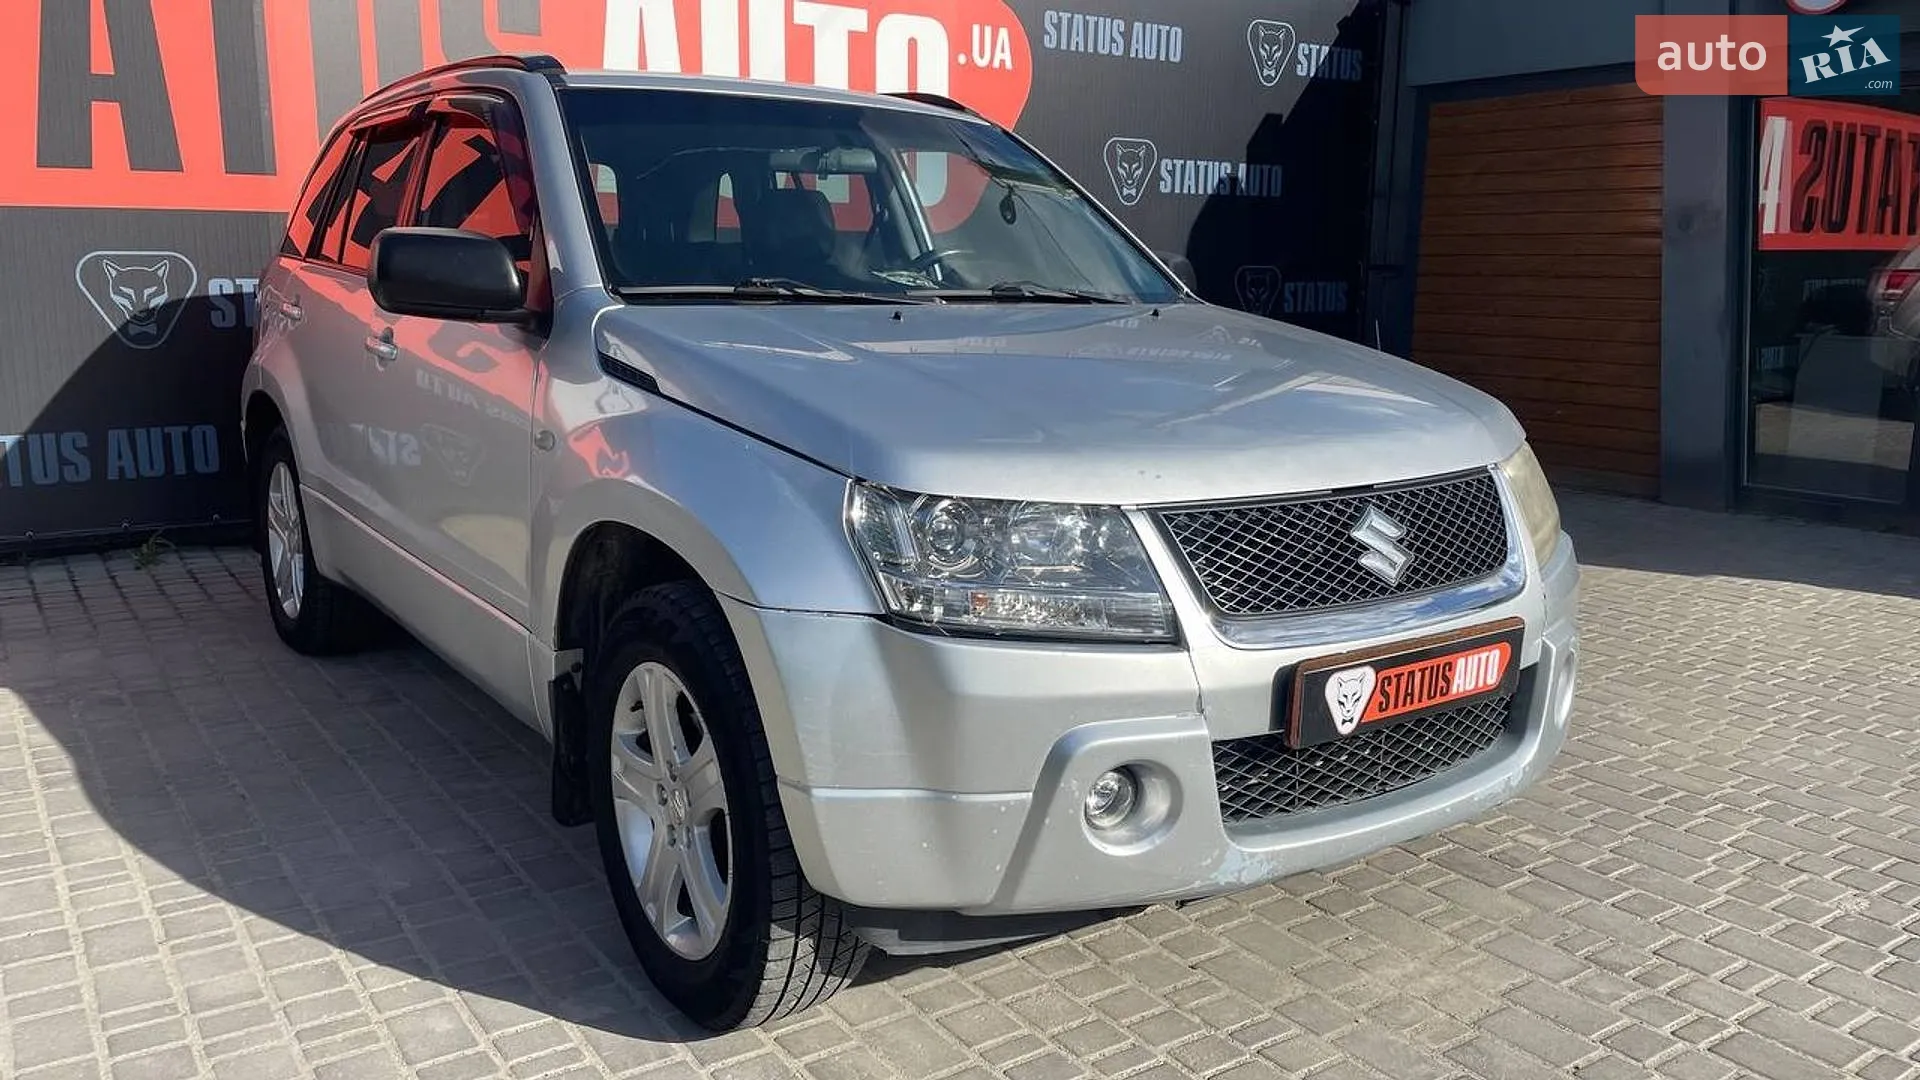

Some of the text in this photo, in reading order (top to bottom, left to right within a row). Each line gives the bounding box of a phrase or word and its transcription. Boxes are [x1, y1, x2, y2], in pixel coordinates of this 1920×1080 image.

[1043, 10, 1183, 64] STATUS AUTO
[1296, 42, 1362, 81] STATUS
[1159, 157, 1282, 197] STATUS AUTO
[1283, 281, 1347, 313] STATUS
[0, 424, 221, 488] TUS AUTO
